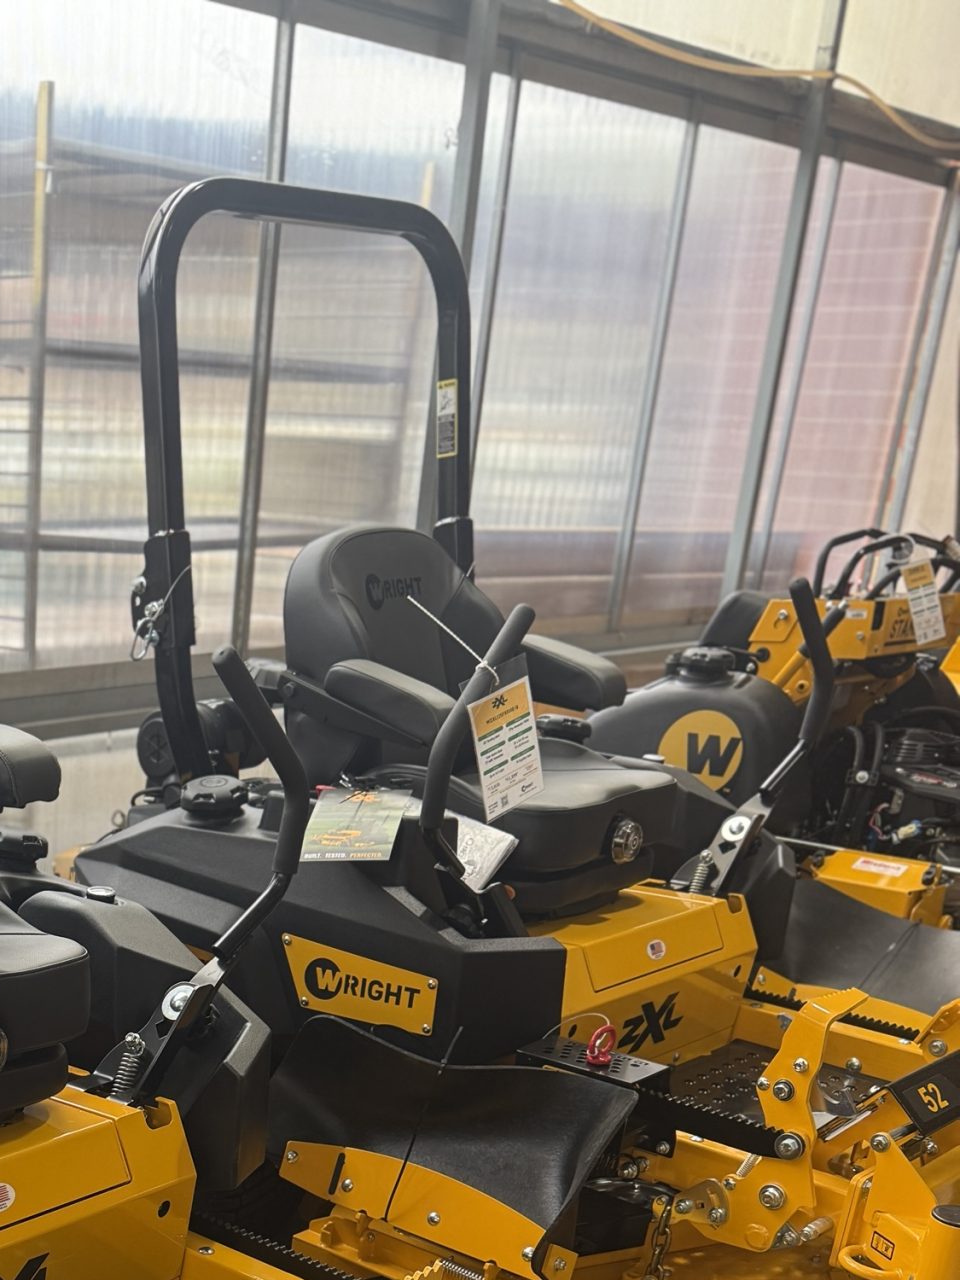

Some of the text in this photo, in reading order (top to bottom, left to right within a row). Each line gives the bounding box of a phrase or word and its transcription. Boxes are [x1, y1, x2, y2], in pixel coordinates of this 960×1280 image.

[366, 575, 422, 606] WRIGHT
[686, 731, 742, 778] W
[305, 958, 421, 1009] WRIGHT
[617, 991, 684, 1055] ZXL
[917, 1082, 949, 1113] 52
